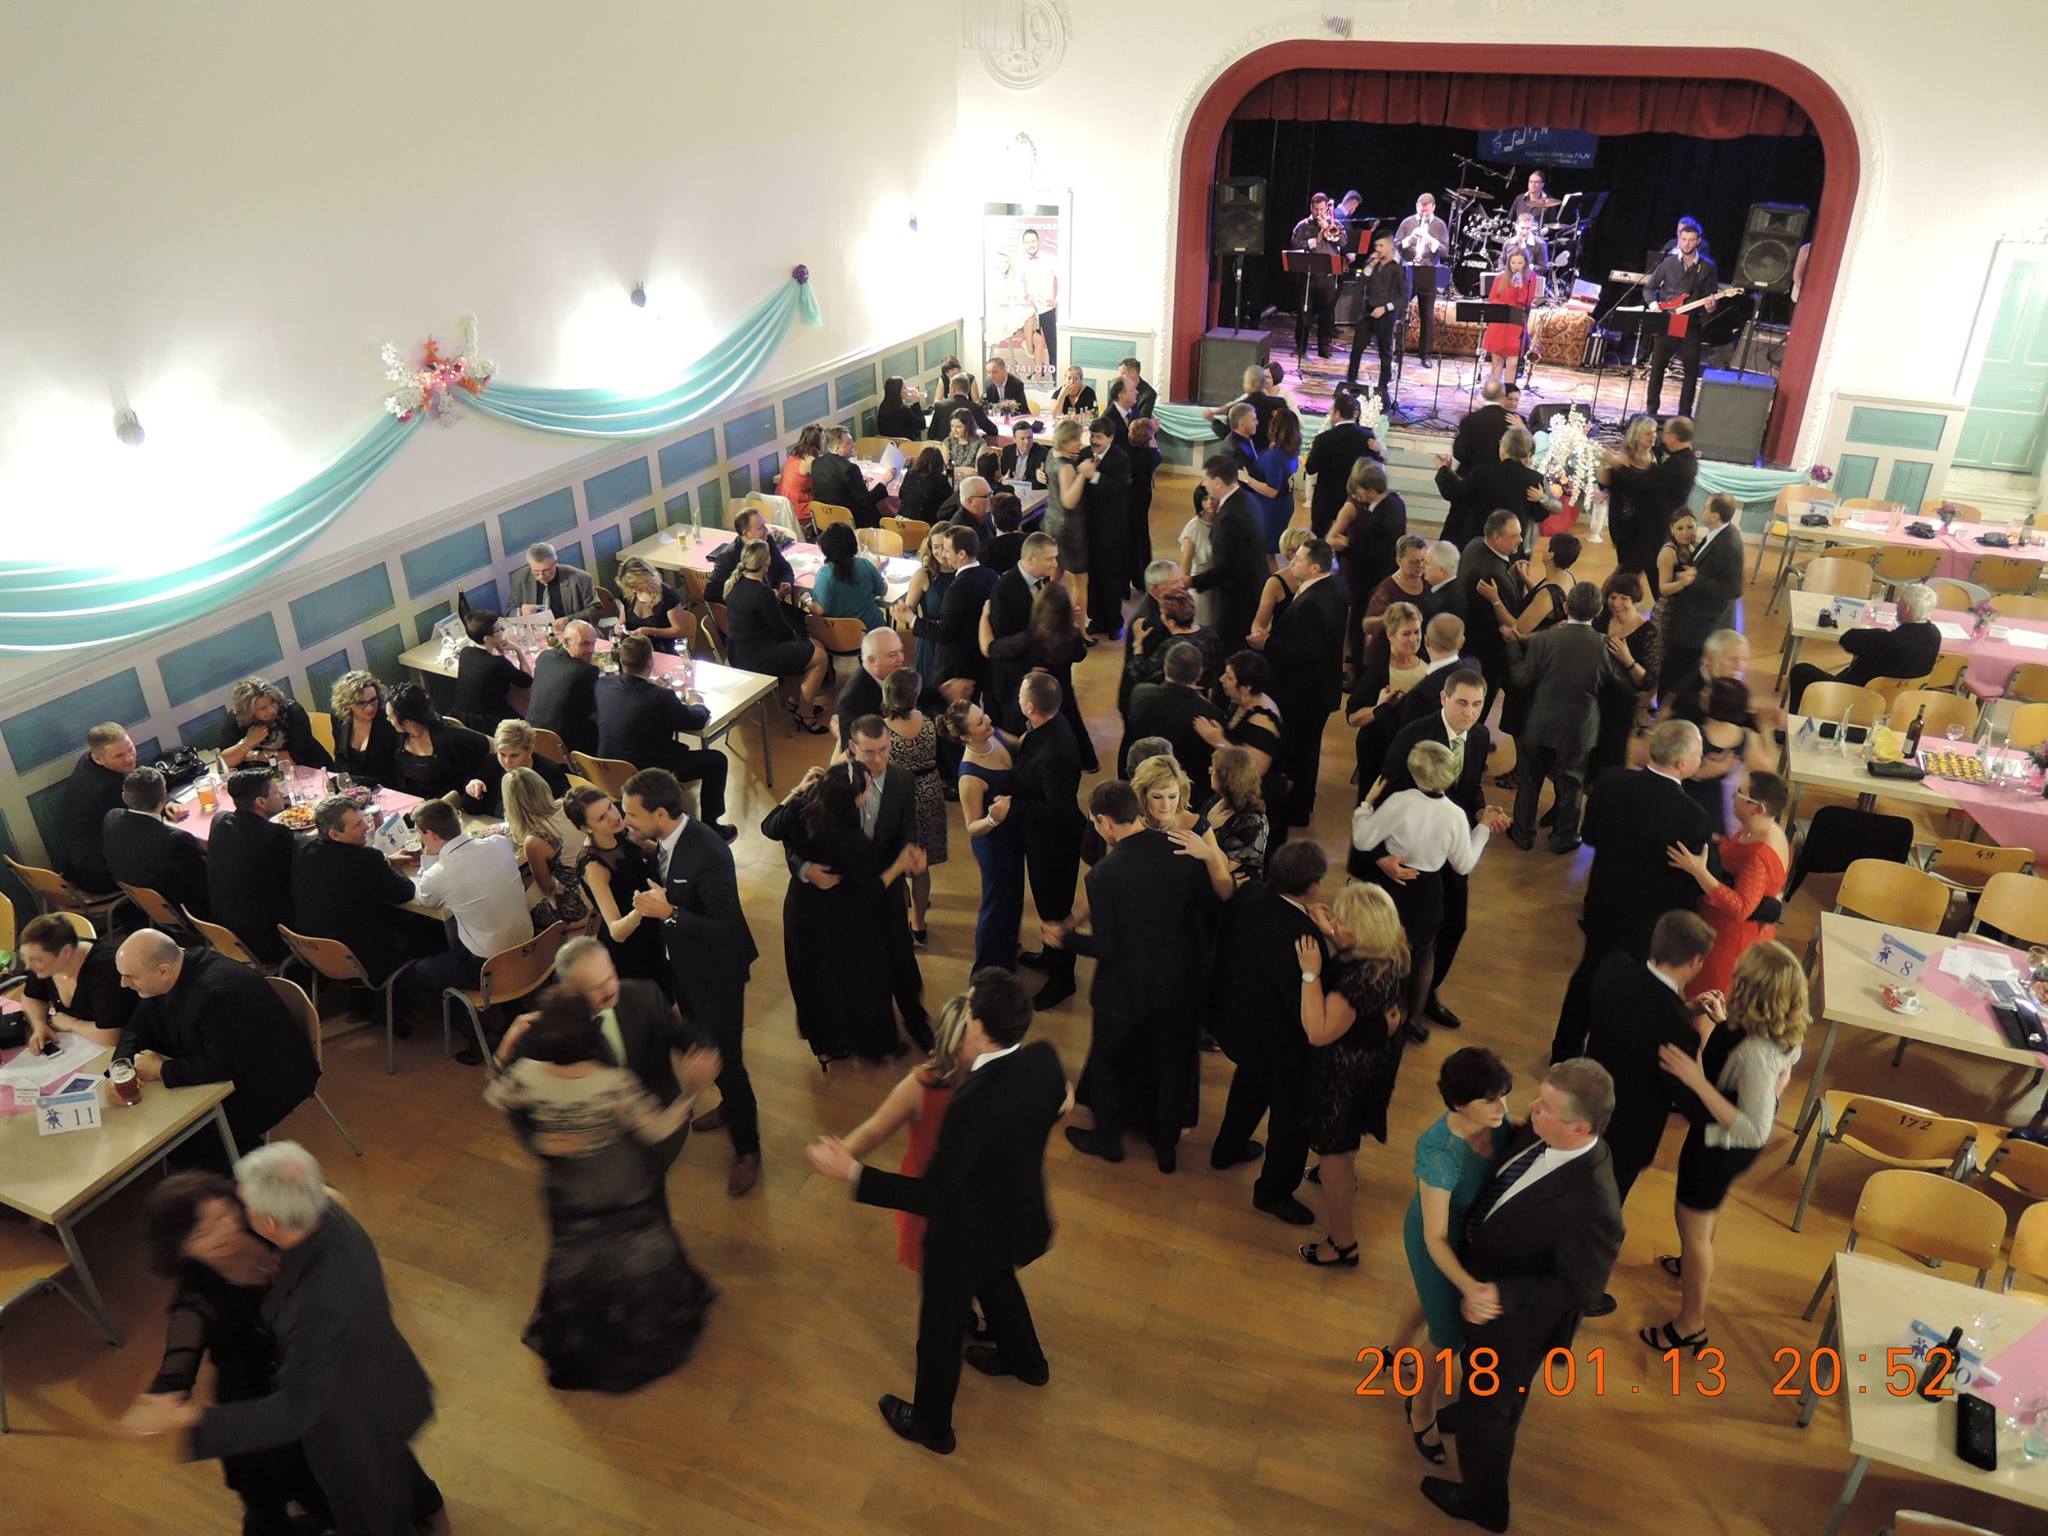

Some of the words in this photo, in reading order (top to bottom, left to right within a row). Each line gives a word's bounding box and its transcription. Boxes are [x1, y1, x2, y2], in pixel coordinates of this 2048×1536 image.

[1975, 849, 1995, 860] 49
[1900, 960, 1913, 976] 8
[74, 1106, 94, 1126] 11
[1899, 1114, 1933, 1131] 172
